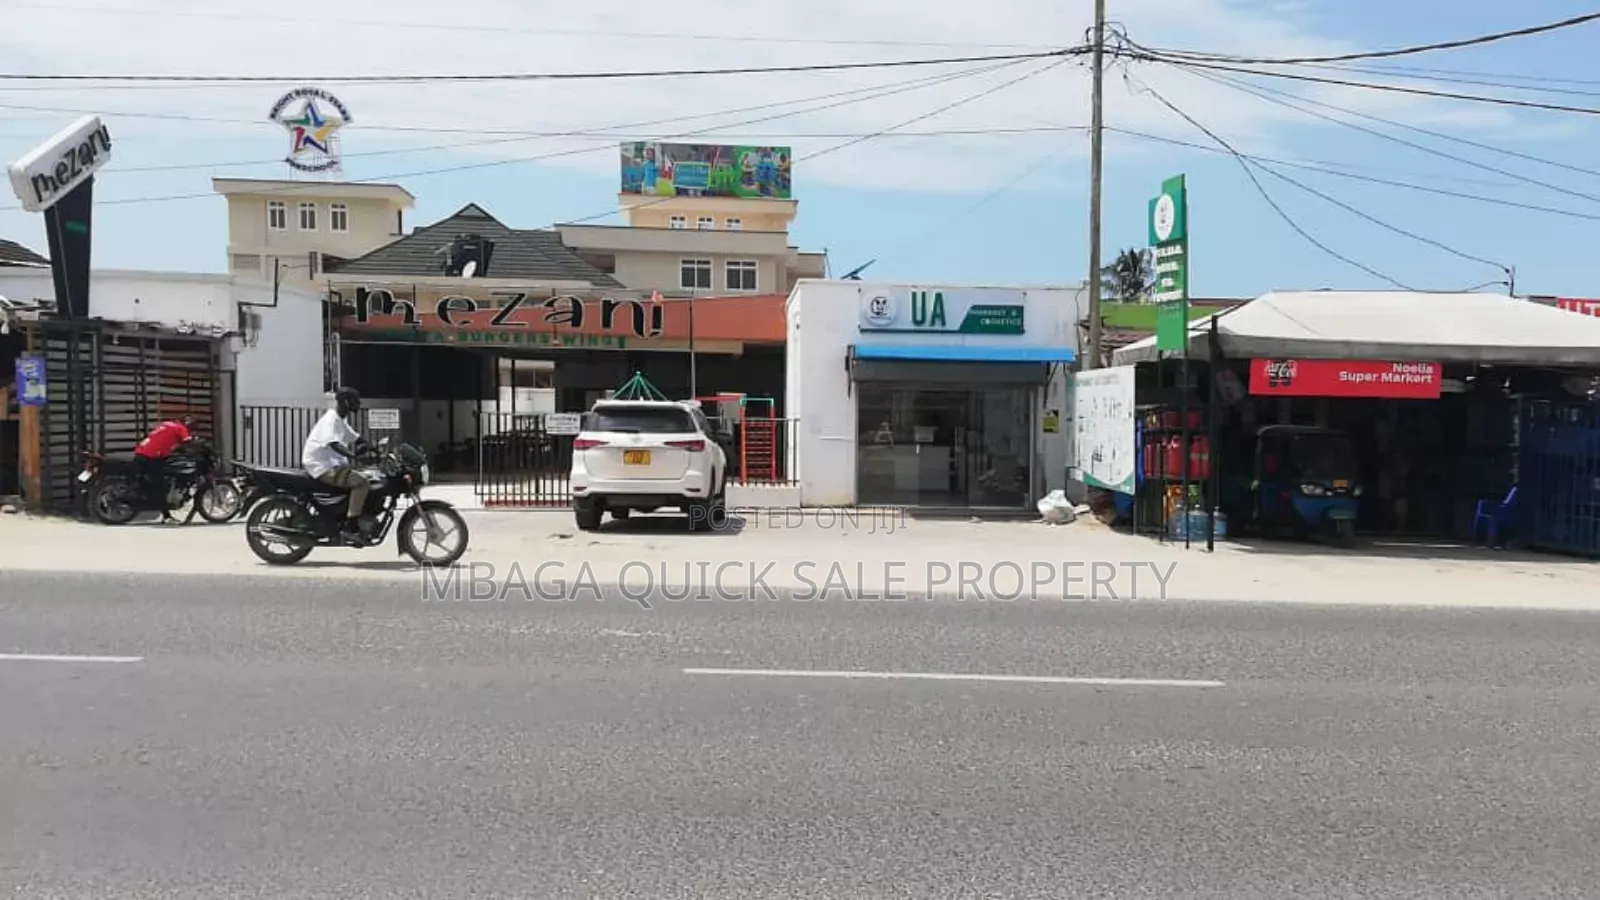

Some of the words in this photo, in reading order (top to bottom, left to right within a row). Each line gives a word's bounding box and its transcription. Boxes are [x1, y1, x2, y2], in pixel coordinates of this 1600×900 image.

[911, 291, 947, 327] UA
[1393, 362, 1434, 374] Noelia
[1339, 371, 1379, 384] Super
